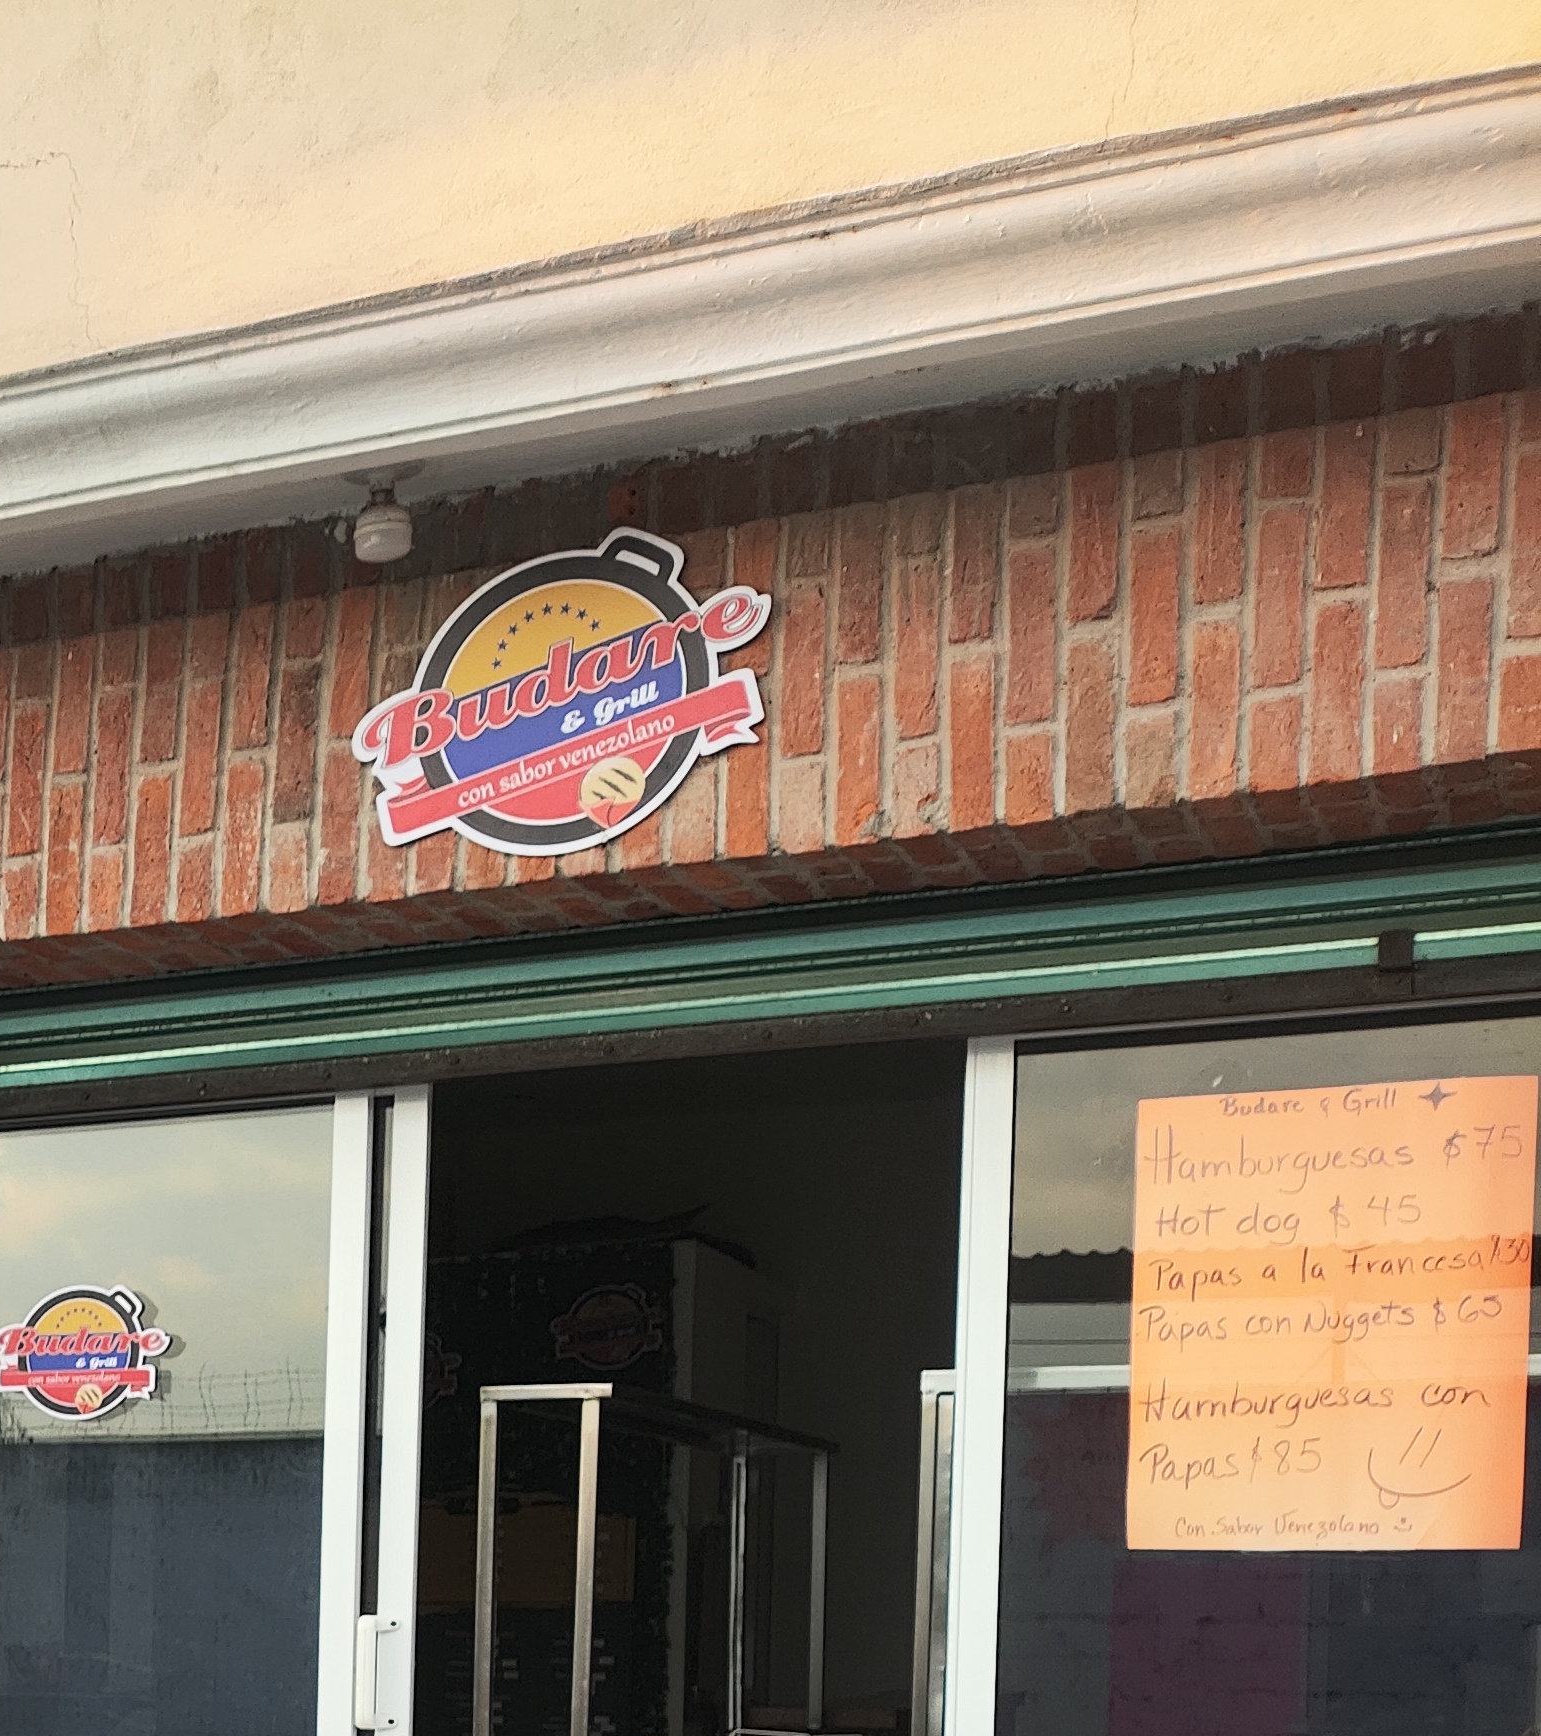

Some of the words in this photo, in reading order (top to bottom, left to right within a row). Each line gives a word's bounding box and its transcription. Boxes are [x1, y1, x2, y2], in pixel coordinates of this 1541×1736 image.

[363, 593, 765, 769] Budare
[560, 709, 585, 734] &
[594, 681, 660, 725] Grill
[457, 783, 495, 809] con
[499, 759, 557, 792] sabor
[560, 715, 676, 772] venezolano
[1221, 1095, 1305, 1118] Budare
[1343, 1087, 1398, 1120] Grill
[1143, 1123, 1414, 1193] Hamburguesas
[1156, 1203, 1227, 1238] Hot
[1235, 1202, 1301, 1245] dog
[1148, 1258, 1243, 1303] Papas
[1262, 1265, 1277, 1283] a
[1301, 1246, 1326, 1285] la
[1138, 1304, 1228, 1353] Papas
[1245, 1312, 1292, 1336] con
[28, 1376, 43, 1385] con
[46, 1372, 70, 1384] sabor
[89, 1356, 118, 1370] Grill
[1138, 1378, 1395, 1429] Hamburguesas
[1420, 1382, 1493, 1409] con
[1138, 1442, 1240, 1491] Papas
